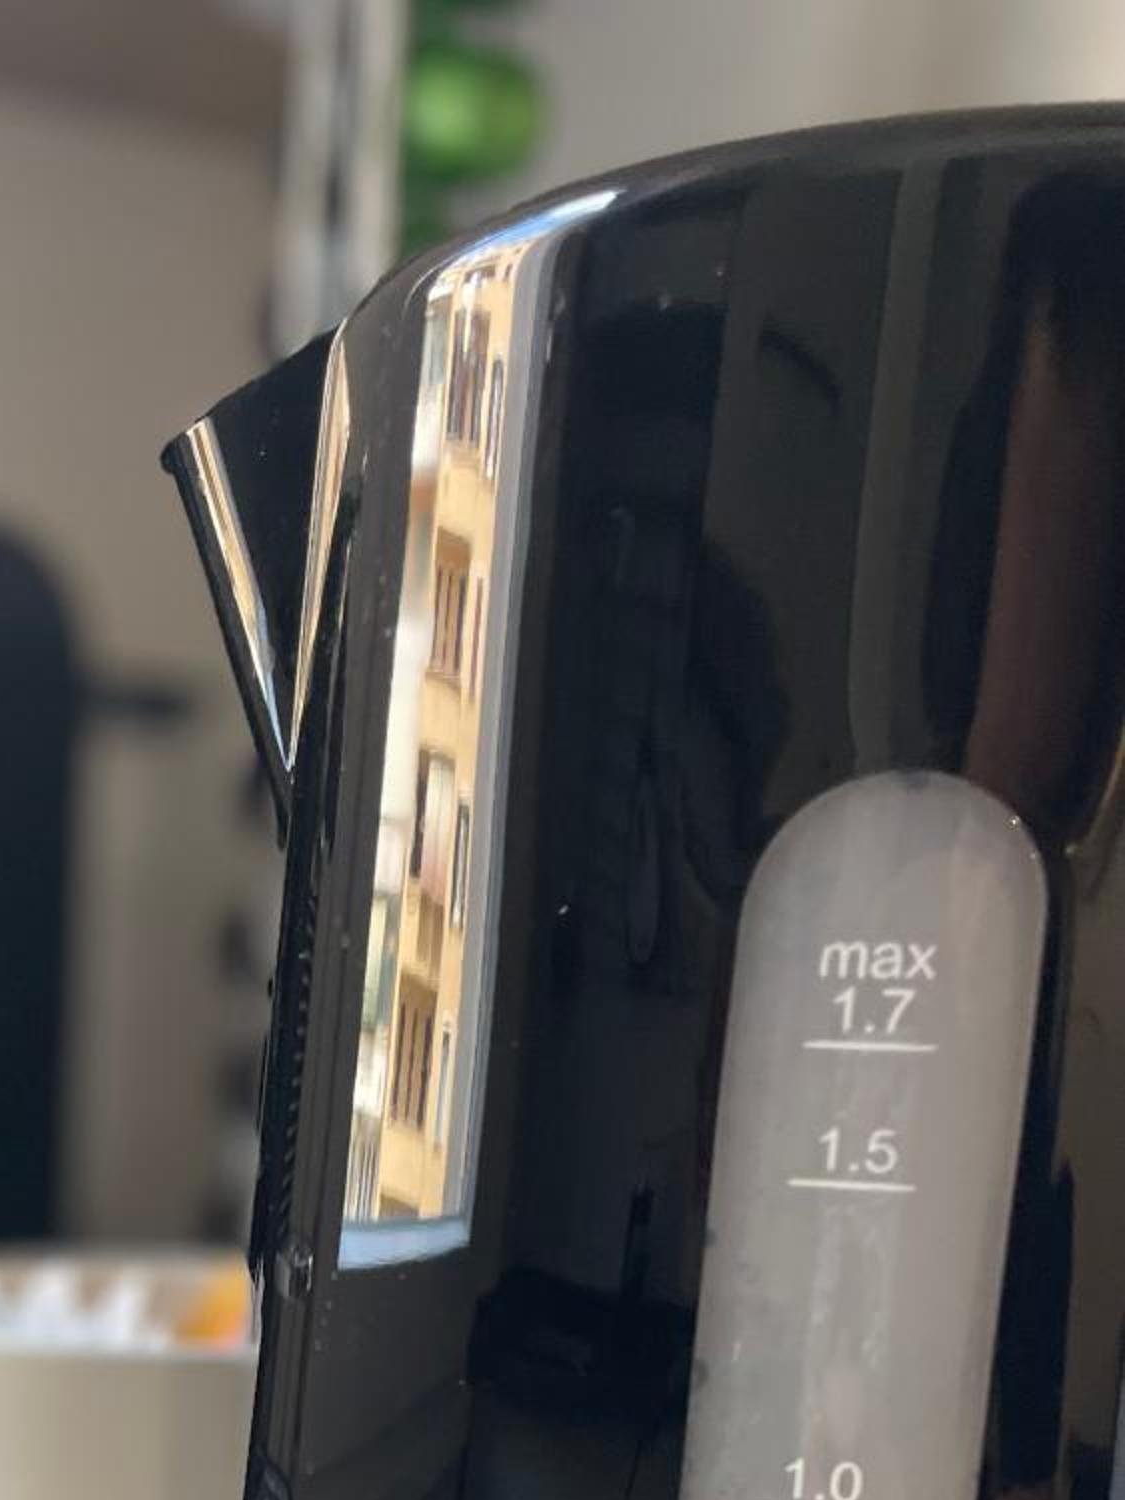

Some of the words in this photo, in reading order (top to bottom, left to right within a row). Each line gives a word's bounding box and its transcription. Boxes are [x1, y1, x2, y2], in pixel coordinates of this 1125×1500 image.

[818, 940, 938, 980] max
[832, 985, 916, 1034] 1.7
[818, 1126, 899, 1174] 1.5
